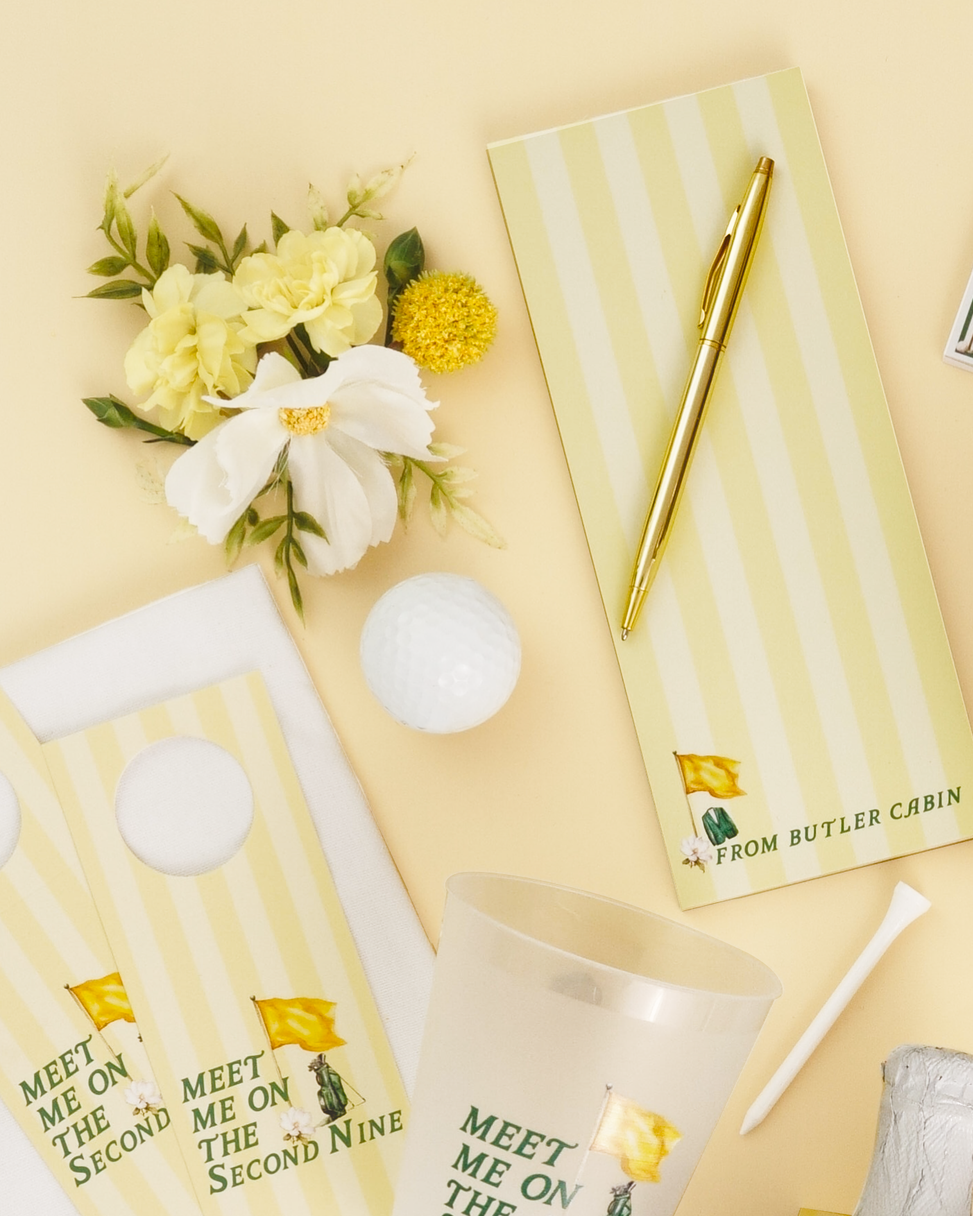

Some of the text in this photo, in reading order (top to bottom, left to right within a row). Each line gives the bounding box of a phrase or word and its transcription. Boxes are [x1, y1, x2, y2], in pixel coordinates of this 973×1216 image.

[716, 787, 962, 865] FROM BUTLER CABIN
[18, 1034, 94, 1107] MEET
[36, 1053, 128, 1132] ME ON
[181, 1050, 265, 1103] MEET
[52, 1105, 110, 1159] THE
[191, 1077, 291, 1133] ME ON
[459, 1105, 579, 1167] MEET
[68, 1107, 171, 1187] SECOND
[198, 1122, 259, 1164] THE
[209, 1109, 403, 1195] SECOND NINE
[451, 1142, 584, 1210] ME ON
